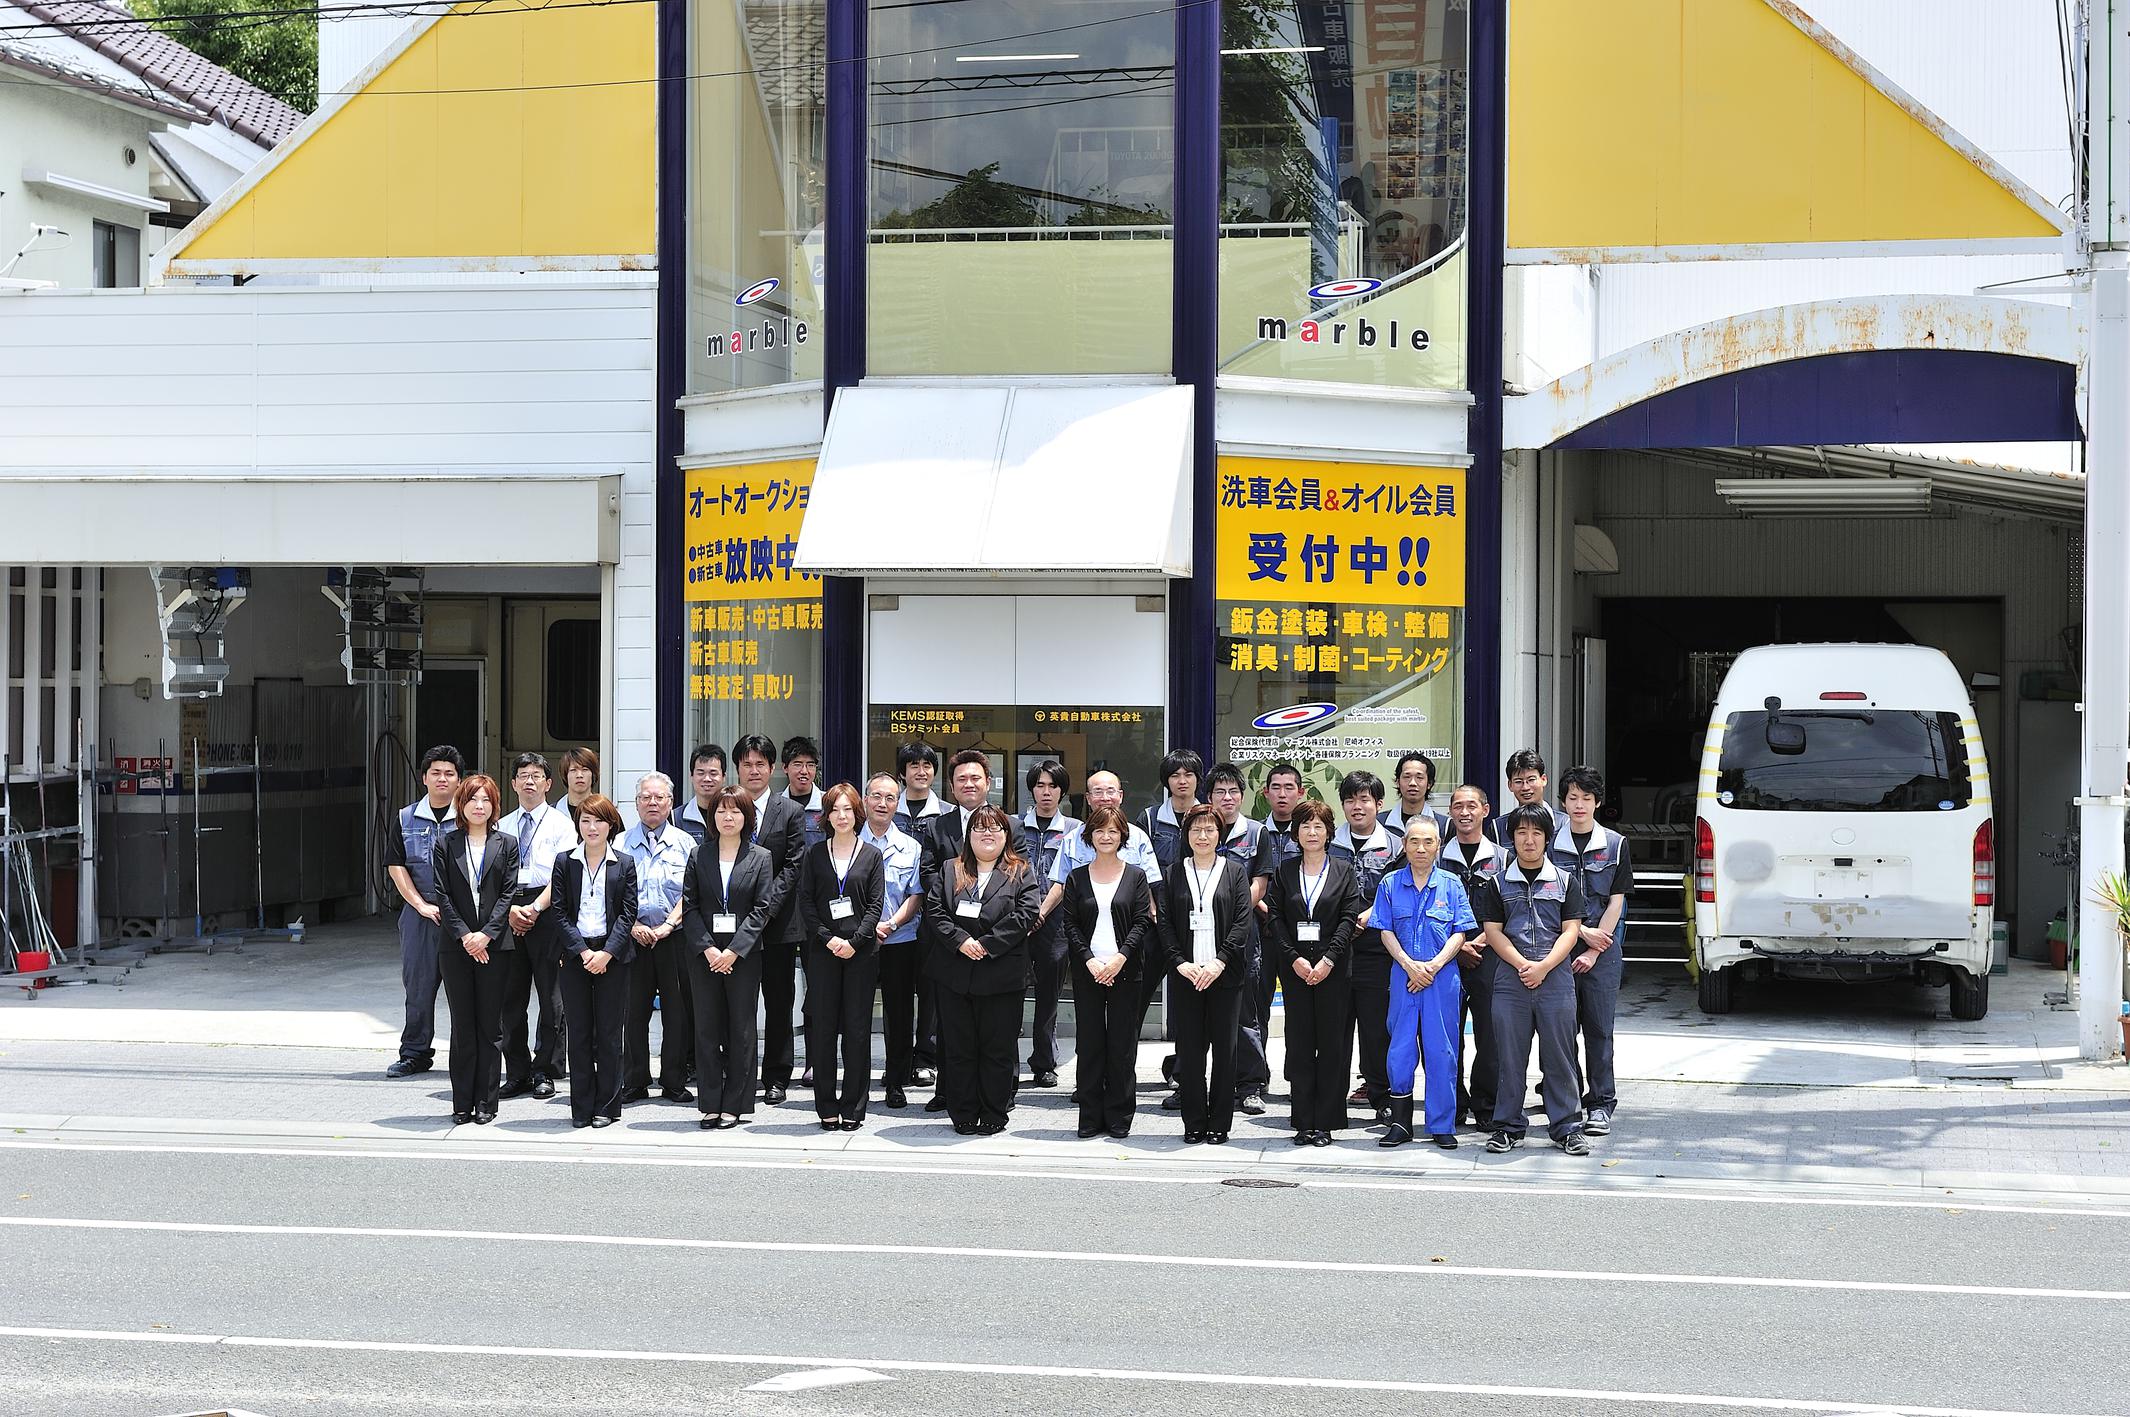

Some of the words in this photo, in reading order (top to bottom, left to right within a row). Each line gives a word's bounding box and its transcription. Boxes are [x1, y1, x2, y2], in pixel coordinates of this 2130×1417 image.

[707, 317, 808, 357] marble
[1258, 316, 1430, 351] marble
[1221, 474, 1457, 518] 洗車会員&オイル会員
[697, 539, 723, 560] 中古車
[725, 533, 821, 584] 放映中
[1247, 532, 1431, 587] 受付中!!
[697, 561, 723, 582] 新古車
[690, 602, 823, 632] 新車販売・中古車販売
[690, 640, 758, 666] 新古車販売
[1230, 643, 1451, 674] 消臭・制菌・コーティング
[890, 710, 965, 721] KEMS認証取得
[890, 723, 961, 734] BSサミット会員
